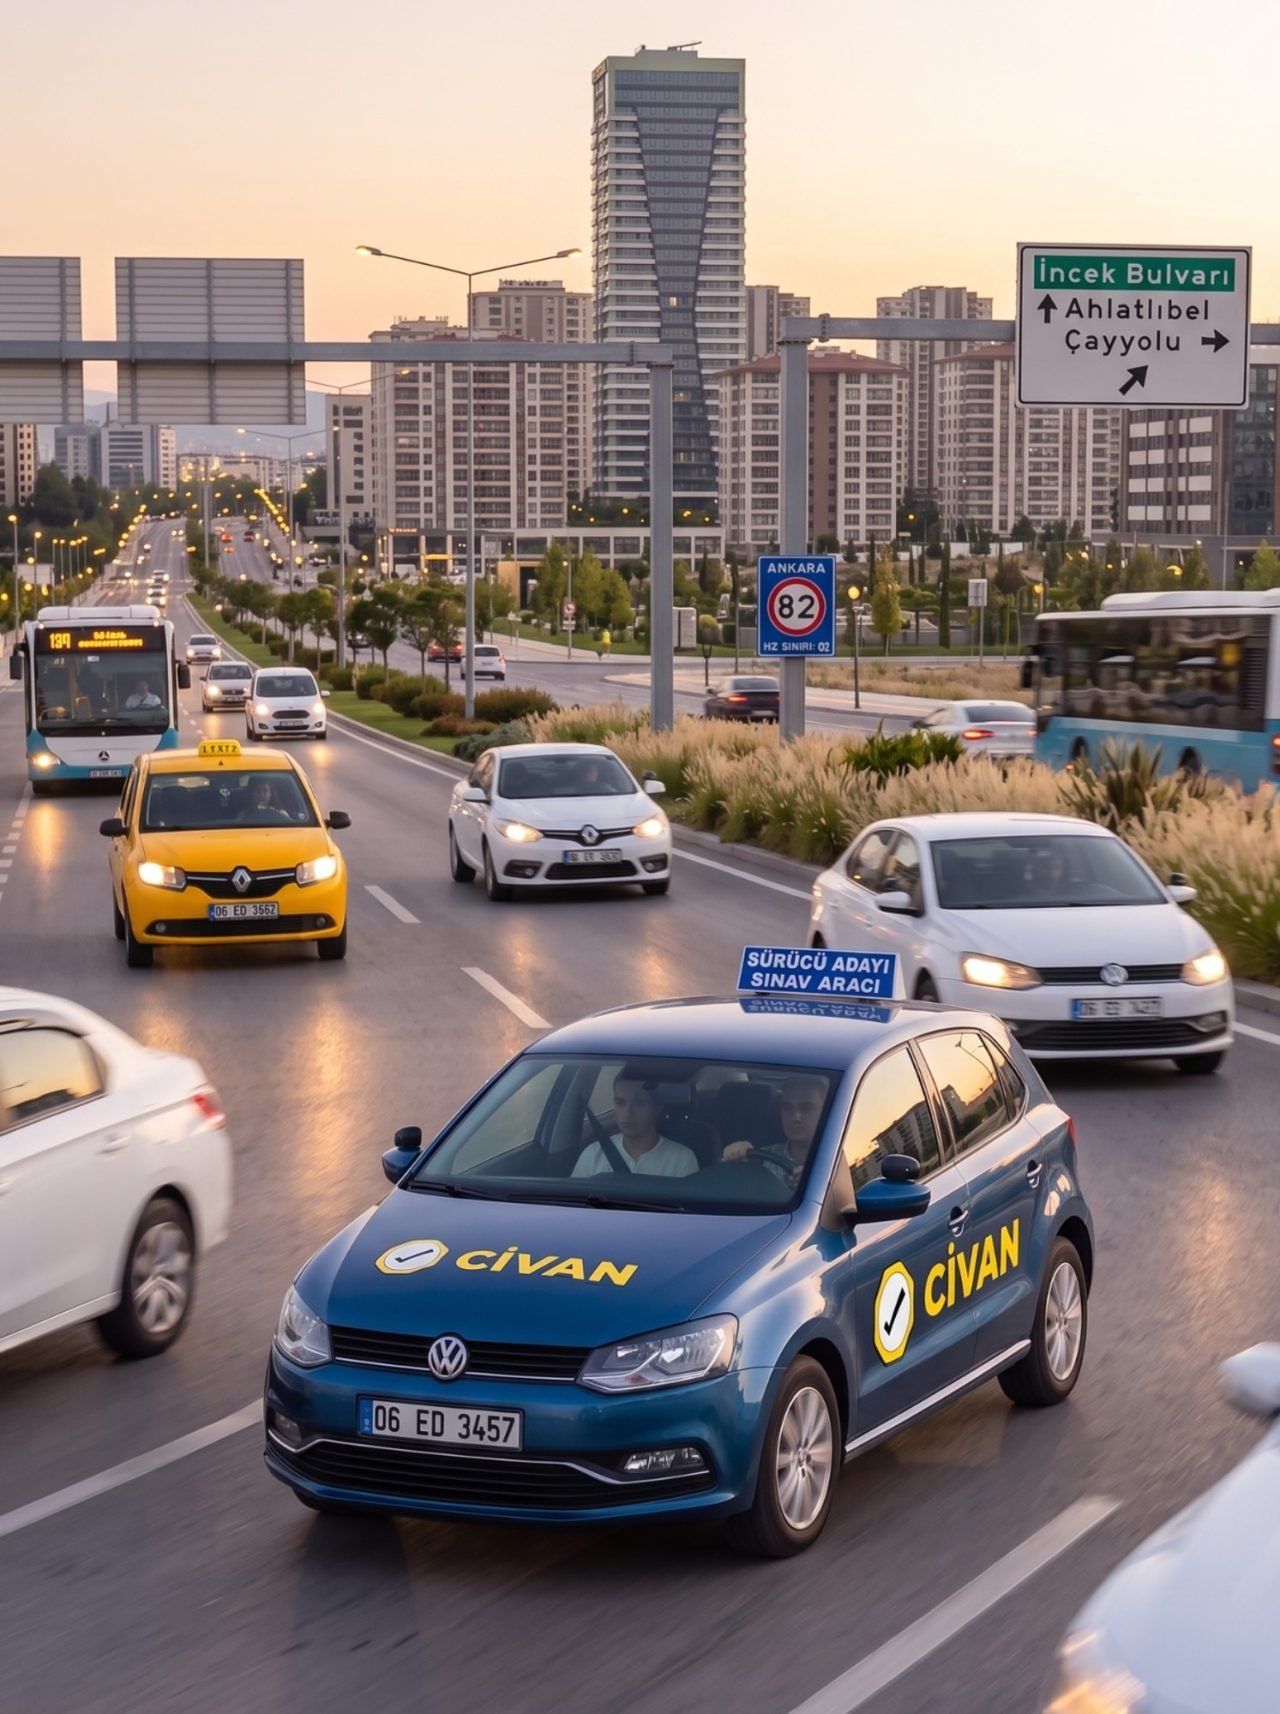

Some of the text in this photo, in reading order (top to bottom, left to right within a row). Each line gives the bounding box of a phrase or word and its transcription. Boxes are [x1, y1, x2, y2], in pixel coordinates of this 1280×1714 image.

[1039, 257, 1229, 286] İncek Bulvarı
[1064, 297, 1209, 321] Ahlatlıbel
[1064, 328, 1181, 357] Çayyolu
[767, 562, 826, 574] ANKARA
[778, 594, 815, 620] 82
[215, 905, 228, 917] 06
[233, 904, 247, 916] ED
[747, 949, 890, 975] SÜRÜCÜ ADAYI
[750, 971, 881, 994] SINAV ARACI
[374, 1405, 400, 1433] 06
[416, 1408, 445, 1438] ED
[457, 1413, 515, 1444] 3457
